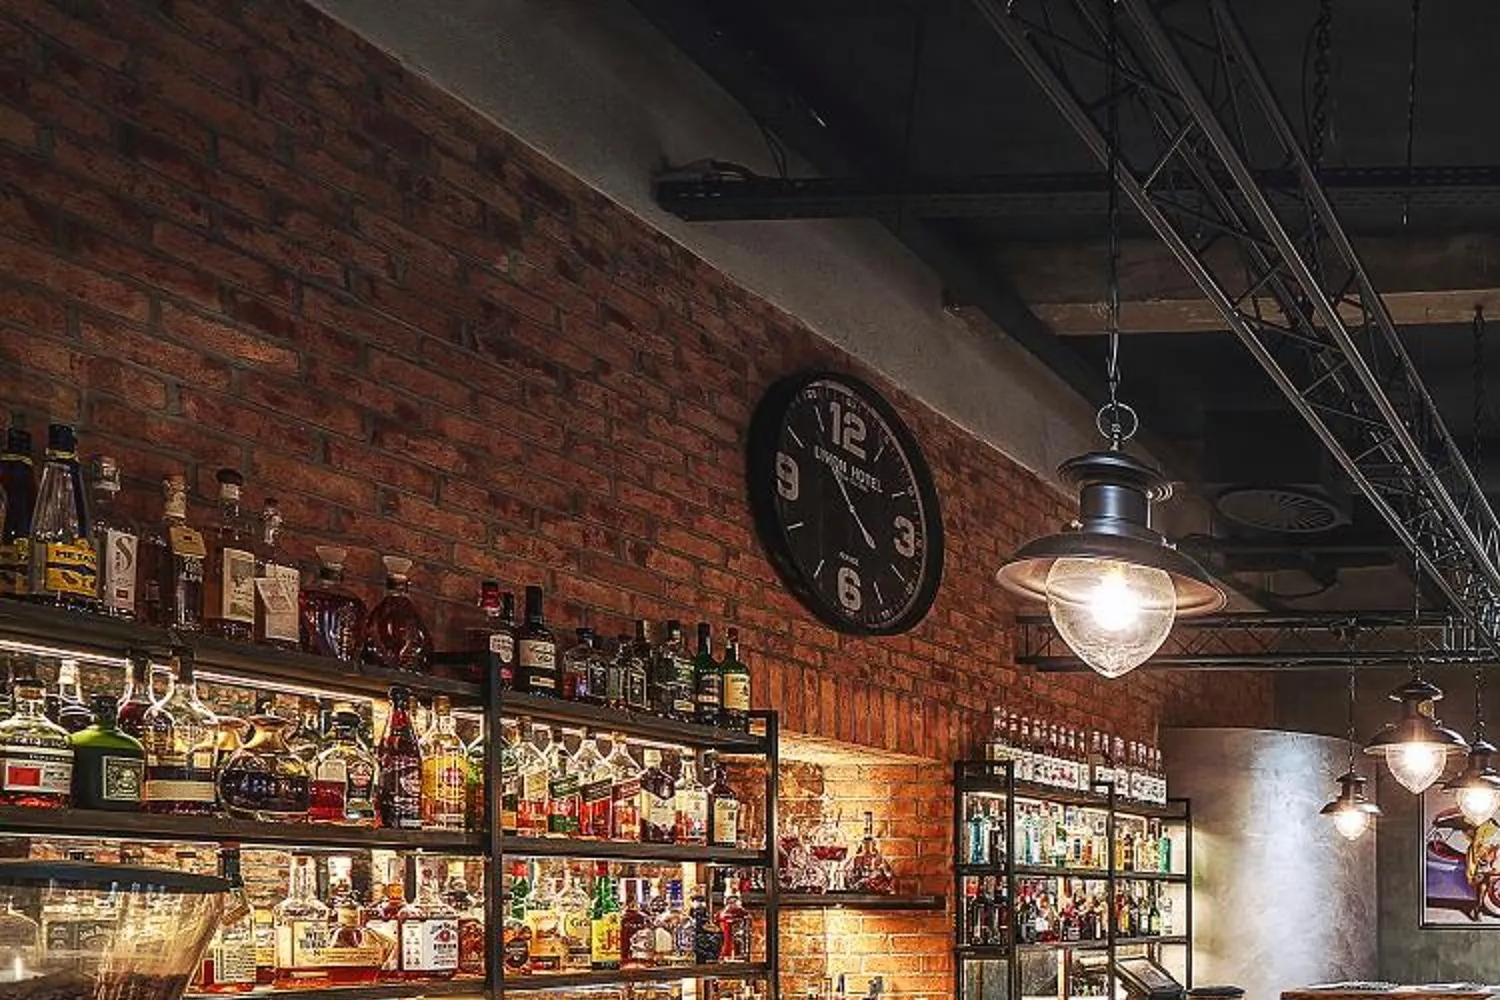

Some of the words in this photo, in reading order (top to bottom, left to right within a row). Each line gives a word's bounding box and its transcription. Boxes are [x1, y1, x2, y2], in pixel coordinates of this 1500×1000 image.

[829, 401, 867, 460] 12
[775, 451, 799, 501] 9
[851, 463, 883, 493] HOTEL
[893, 515, 915, 559] 3
[837, 566, 862, 612] 6
